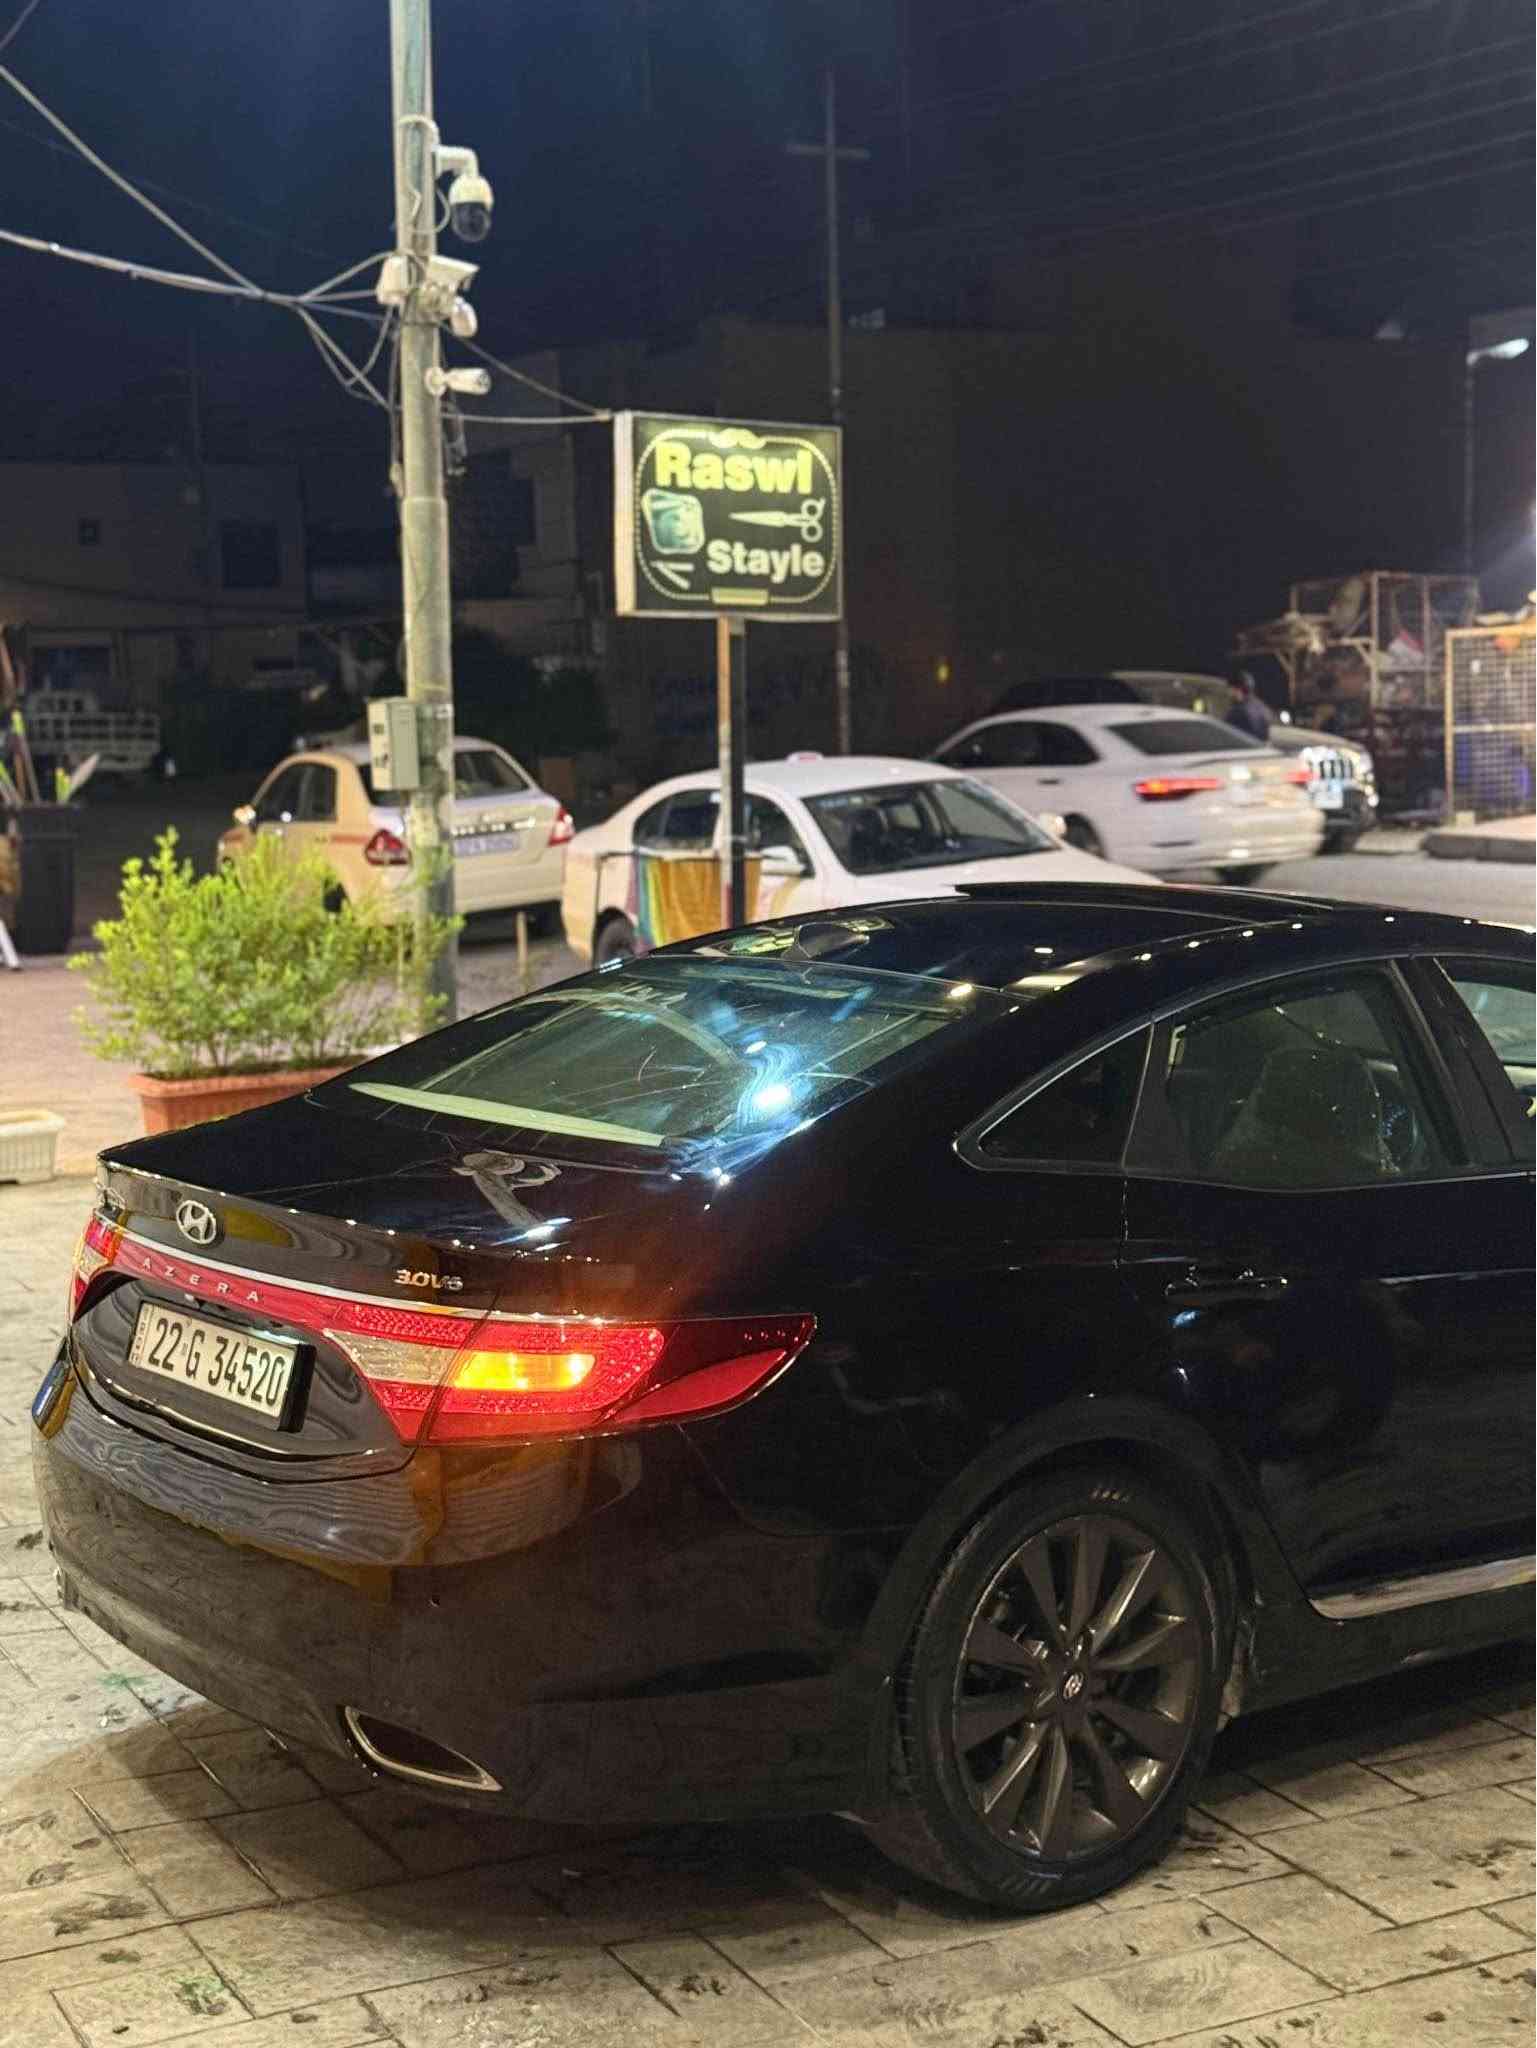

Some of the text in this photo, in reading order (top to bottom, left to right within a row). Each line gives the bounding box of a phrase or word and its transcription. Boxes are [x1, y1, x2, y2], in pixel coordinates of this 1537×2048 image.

[706, 539, 825, 584] Stayle
[141, 1257, 260, 1303] AZERA
[148, 1317, 183, 1372] 22
[185, 1329, 206, 1380] G
[207, 1335, 287, 1407] 34520
